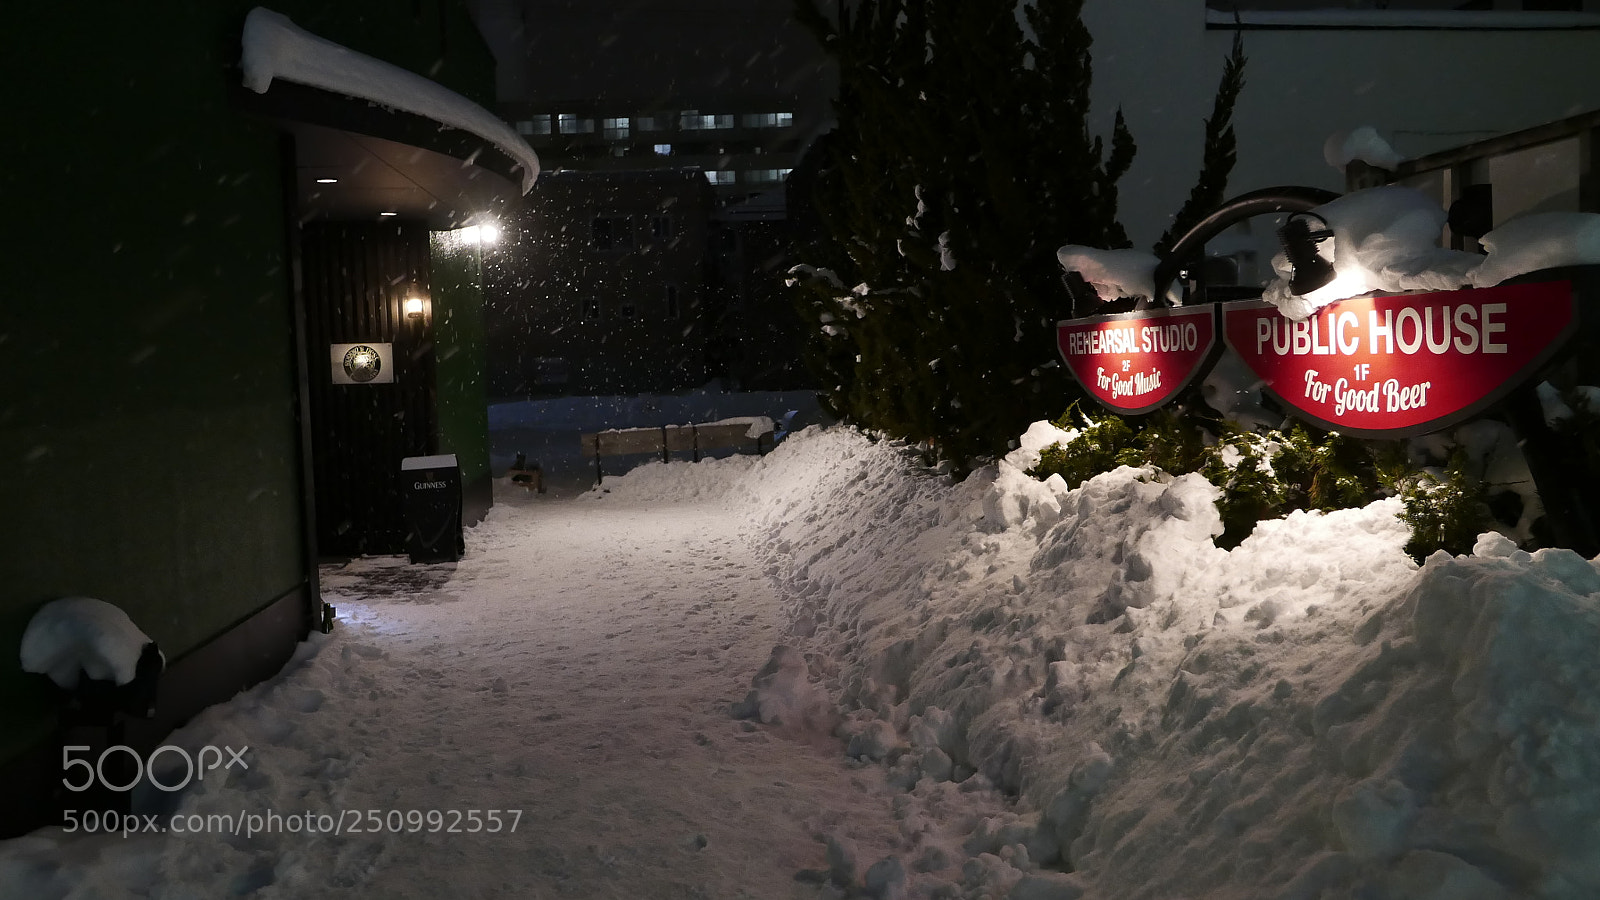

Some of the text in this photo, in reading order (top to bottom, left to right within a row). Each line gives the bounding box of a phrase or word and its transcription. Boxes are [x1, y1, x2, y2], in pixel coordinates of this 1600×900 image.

[1069, 322, 1198, 355] REHEARSAL STUDIO
[1256, 302, 1508, 356] PUBLIC HOUSE
[1121, 359, 1131, 372] 2F
[1353, 363, 1370, 381] 1F
[1097, 366, 1162, 399] For Good Music
[1304, 369, 1431, 416] For Good Beer
[413, 480, 447, 490] GUINNESS
